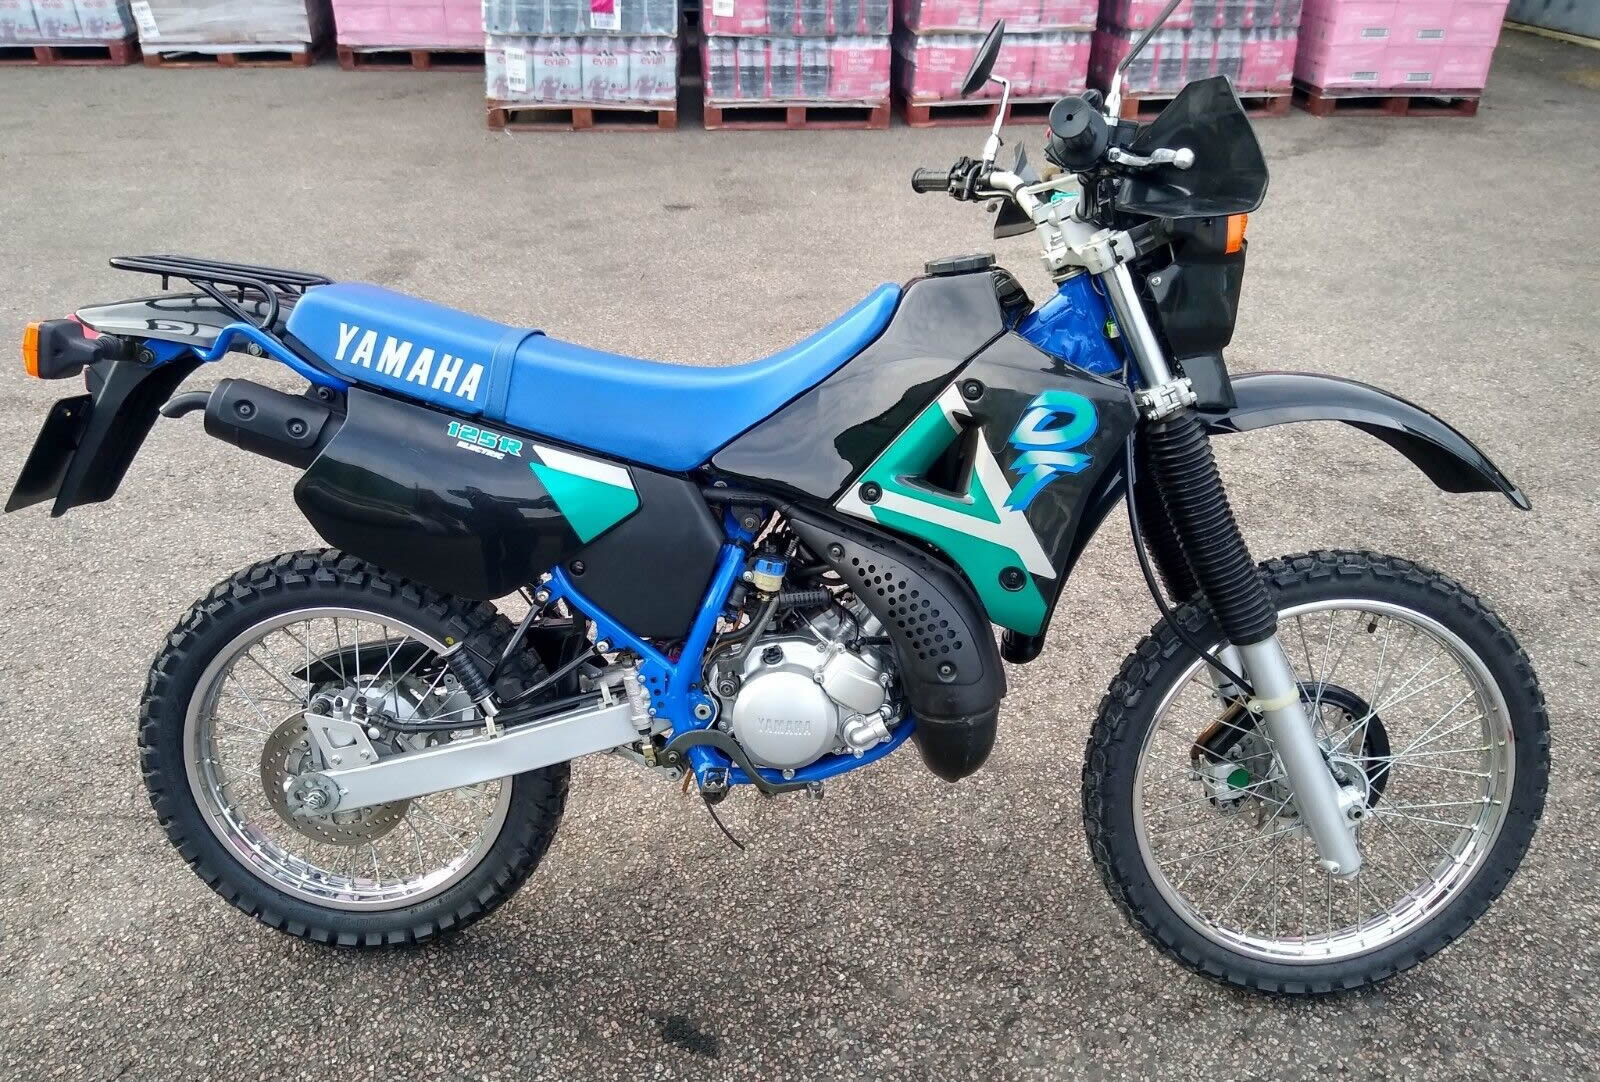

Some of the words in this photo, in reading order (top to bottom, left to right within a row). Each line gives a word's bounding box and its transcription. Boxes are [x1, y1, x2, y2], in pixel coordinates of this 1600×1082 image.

[592, 56, 618, 66] evian
[335, 322, 485, 402] YAMAHA
[447, 420, 523, 457] 125R
[758, 717, 812, 736] YAMAHA
